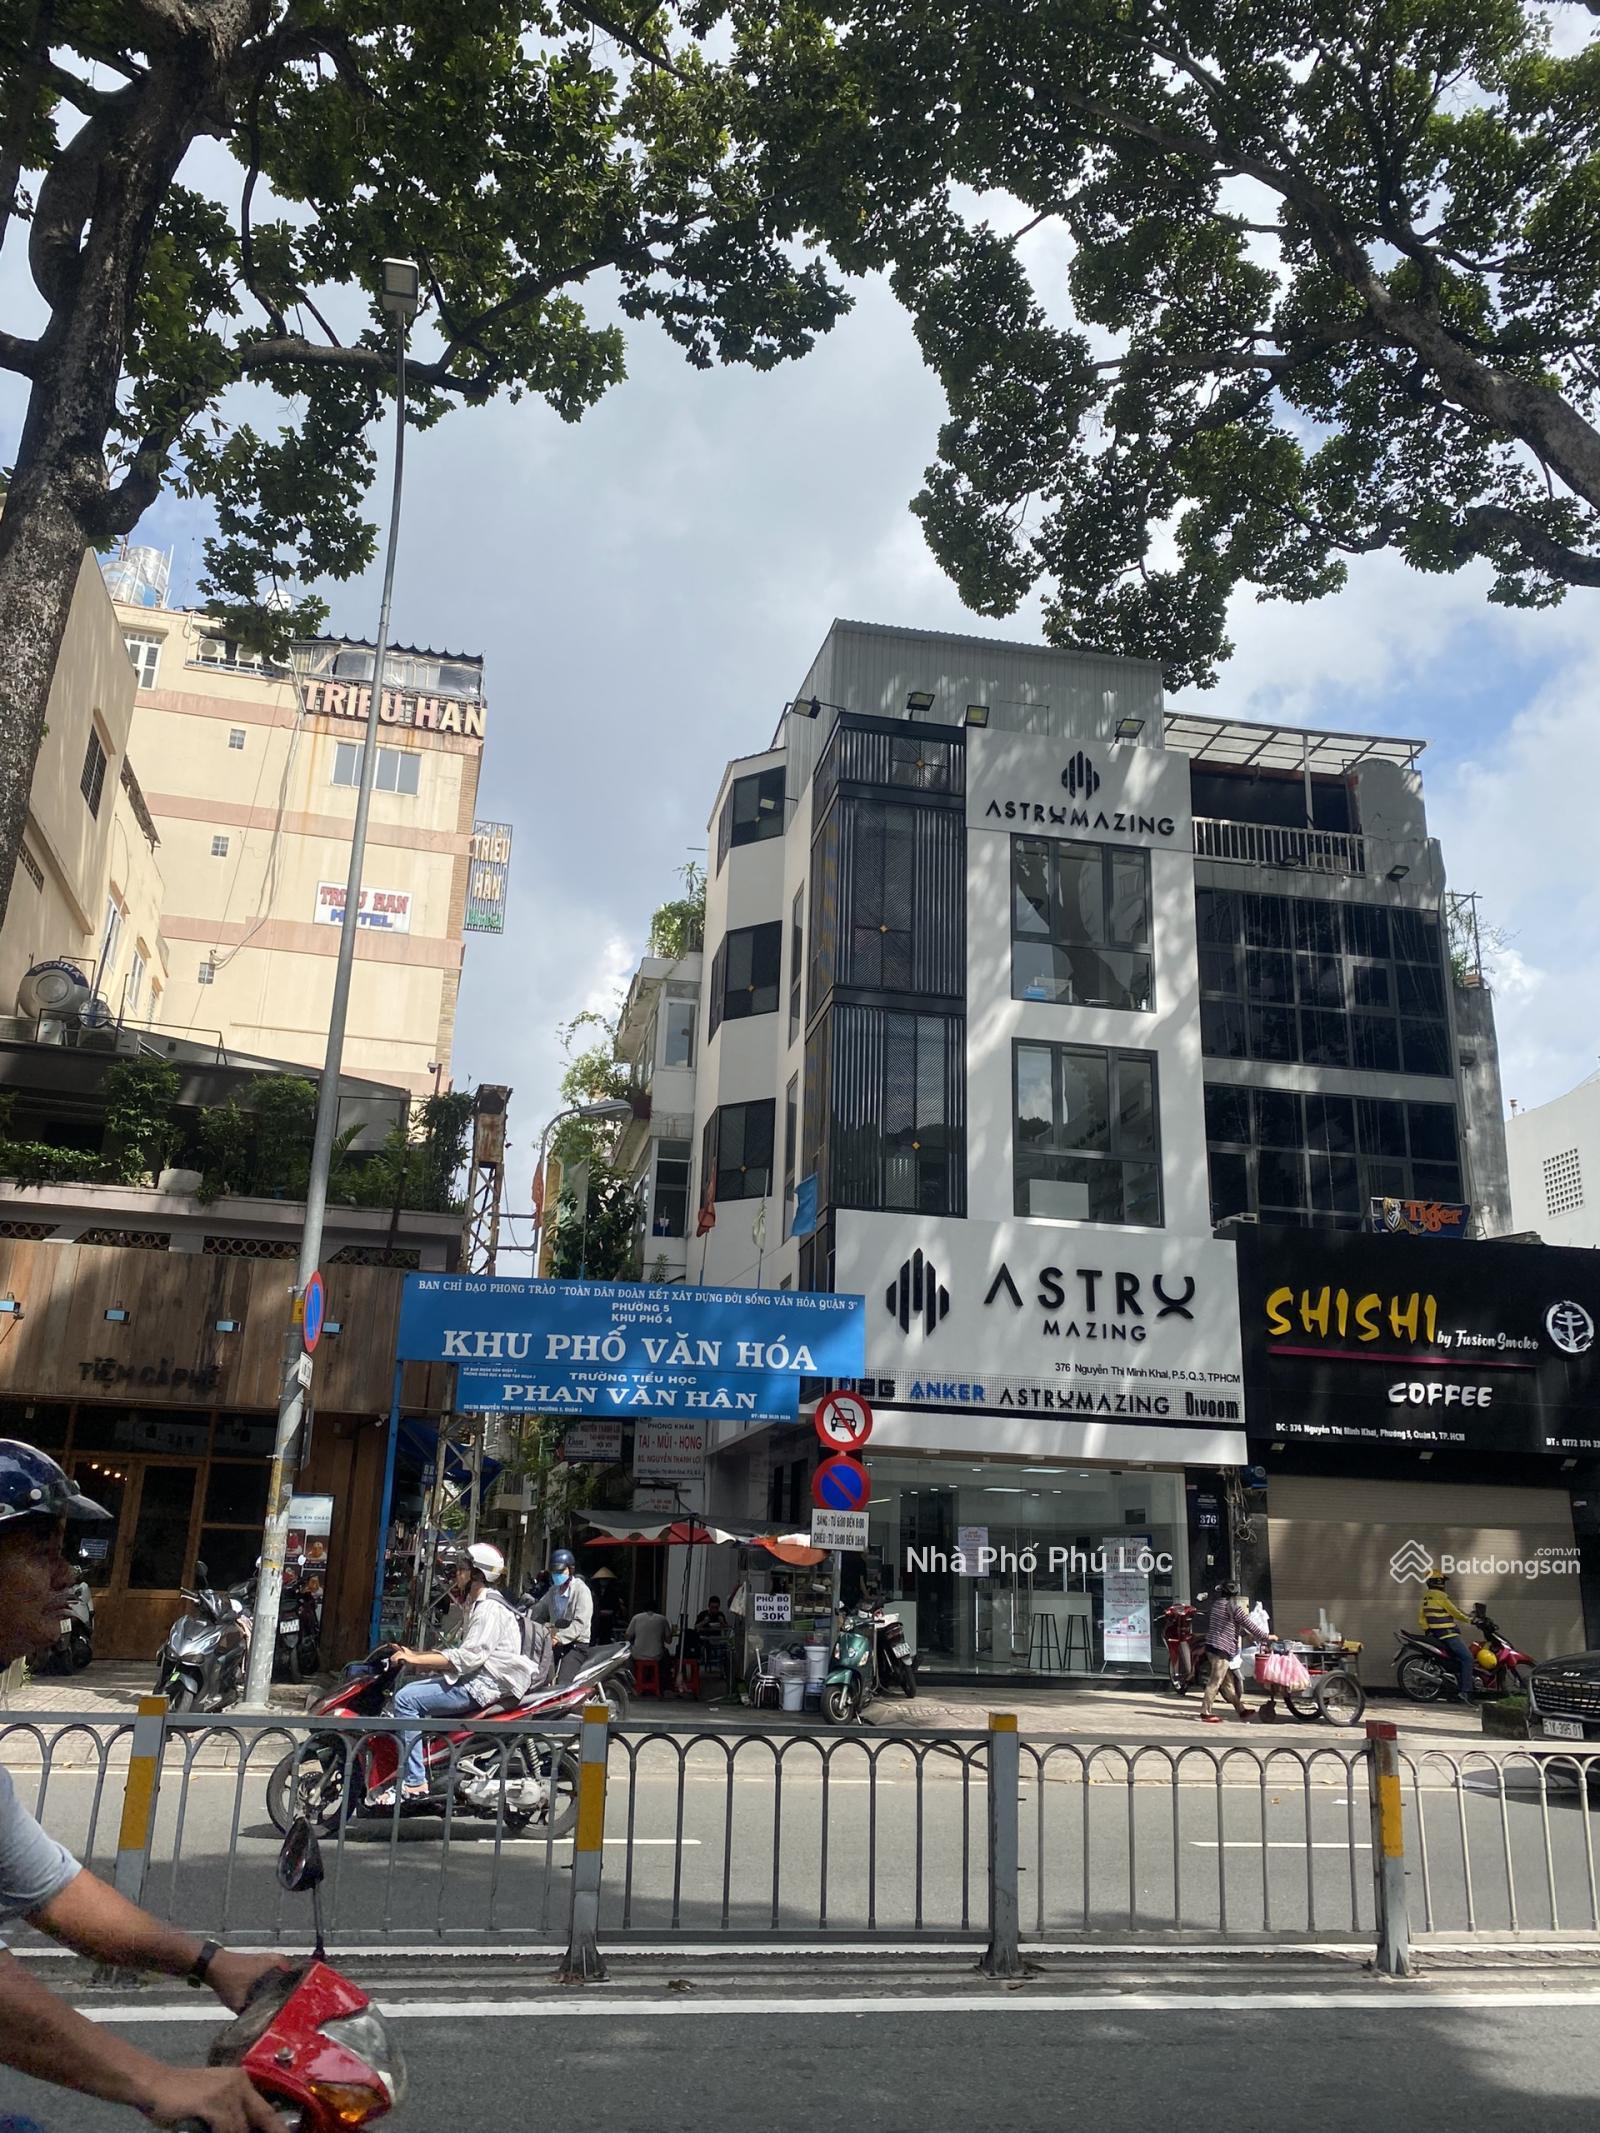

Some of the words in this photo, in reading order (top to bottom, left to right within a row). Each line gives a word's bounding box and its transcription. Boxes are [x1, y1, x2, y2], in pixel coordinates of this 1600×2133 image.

[320, 886, 368, 910] TRIU
[373, 893, 409, 914] HAN
[330, 908, 393, 928] HTEL
[1405, 1200, 1462, 1232] Tiger
[418, 1280, 440, 1291] BAN
[443, 1280, 462, 1291] CHỈ
[465, 1283, 487, 1294] ĐẠO
[490, 1284, 525, 1294] PHONG
[529, 1284, 556, 1295] TRÀO
[594, 1286, 615, 1298] DÂN
[618, 1287, 645, 1300] ĐOÀN
[649, 1288, 670, 1300] KẾT
[672, 1290, 692, 1301] XÂY
[696, 1292, 723, 1305] DỰNG
[725, 1292, 742, 1304] ĐỜI
[745, 1293, 771, 1306] SỐNG
[773, 1295, 793, 1307] VĂN
[797, 1296, 817, 1308] HÓA
[819, 1299, 846, 1311] QUẬN
[612, 1301, 660, 1313] PHƯỜNG
[663, 1304, 670, 1312] 5
[1266, 1286, 1437, 1344] SHISHI
[1437, 1330, 1452, 1348] by
[1455, 1330, 1497, 1348] Fusion
[611, 1313, 636, 1323] KHU
[639, 1312, 663, 1324] PHỐ
[665, 1316, 673, 1325] 4
[1043, 1320, 1147, 1342] MAZING
[441, 1330, 533, 1360] KHU
[545, 1324, 627, 1362] PHỐ
[641, 1332, 722, 1367] VĂN
[736, 1334, 818, 1371] HÓA
[569, 1372, 627, 1383] TRƯỜNG
[632, 1371, 664, 1384] TIỂU
[668, 1375, 697, 1386] HỌC
[1055, 1363, 1071, 1372] 376
[1074, 1363, 1109, 1376] Nguyễn
[1111, 1366, 1125, 1378] Thị
[1127, 1367, 1147, 1378] Minh
[1208, 1372, 1241, 1383] TPHCM
[502, 1384, 599, 1403] PHAN
[606, 1384, 678, 1406] VĂN
[685, 1388, 757, 1409] HÂN
[910, 1380, 985, 1402] ANKER
[1185, 1392, 1239, 1419] Divoom
[1388, 1382, 1493, 1408] COFFEE
[639, 1434, 650, 1449] TAI
[679, 1436, 702, 1452] HỌNG
[1200, 1514, 1217, 1525] 376
[762, 1612, 785, 1620] 30K
